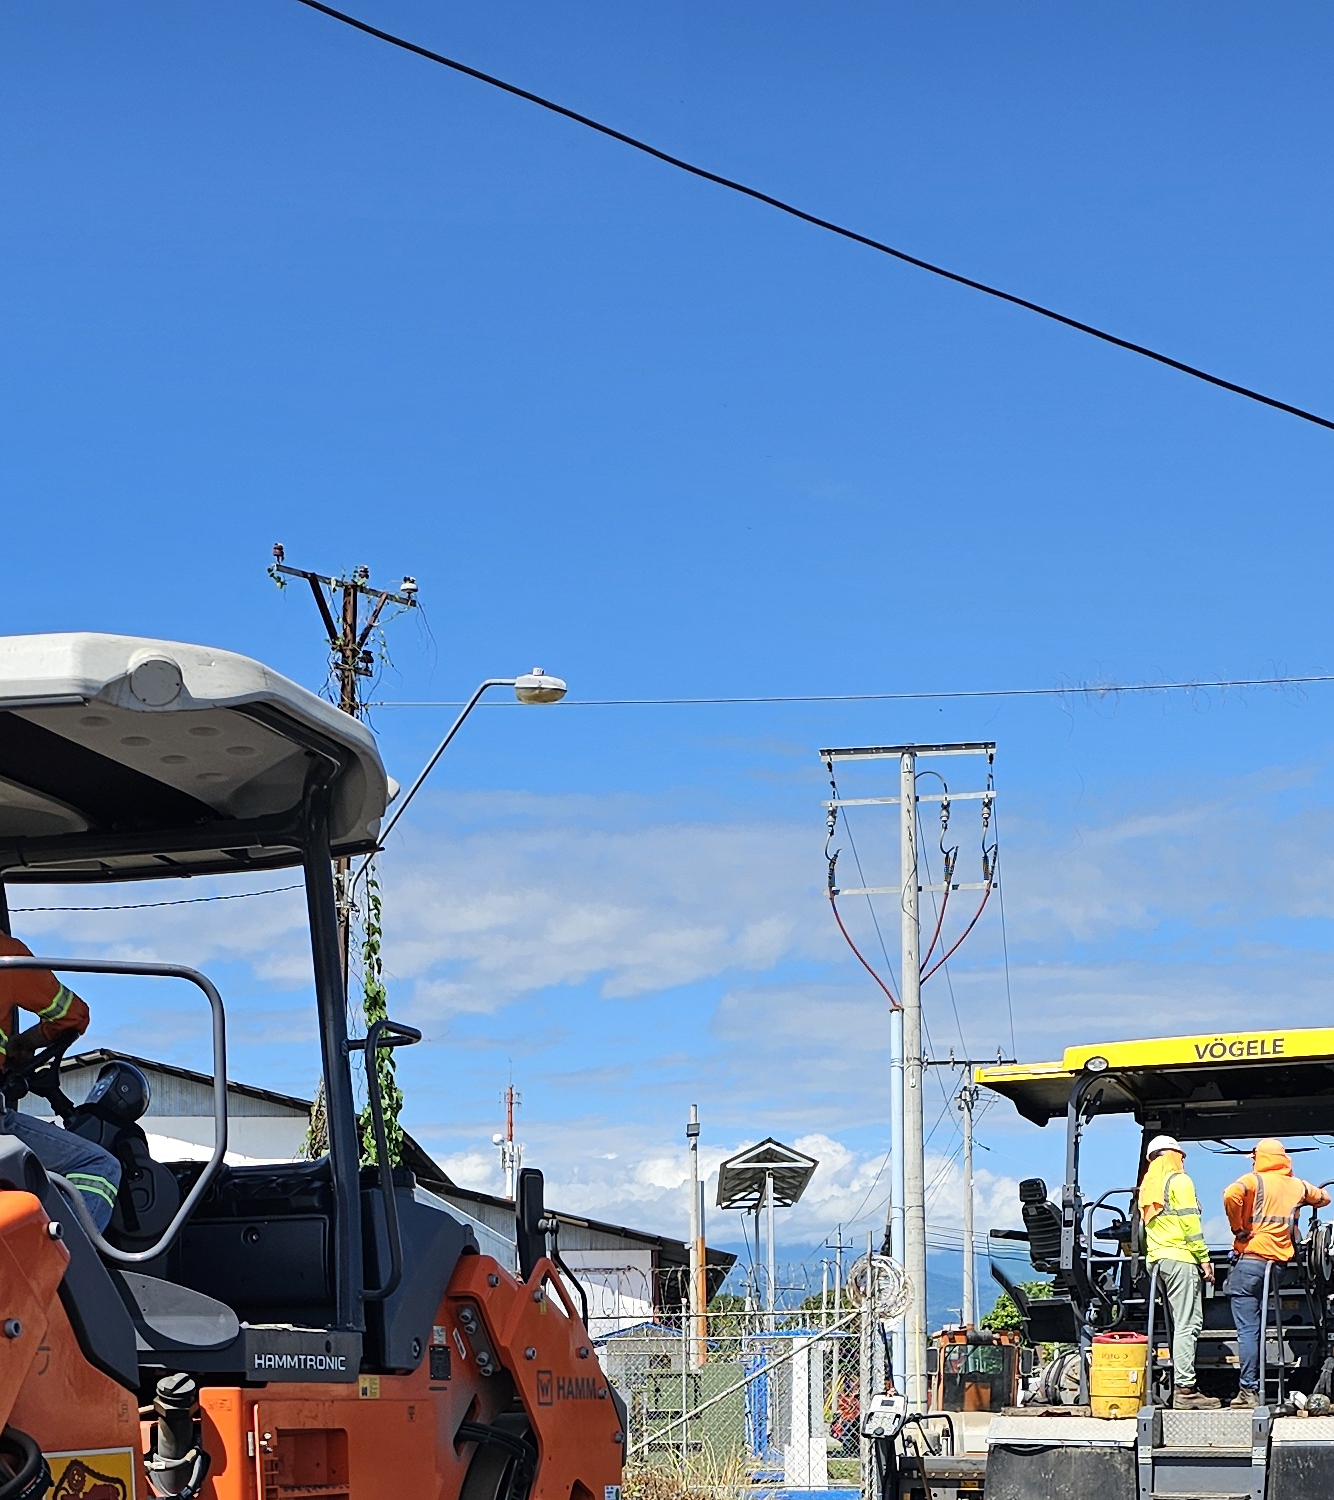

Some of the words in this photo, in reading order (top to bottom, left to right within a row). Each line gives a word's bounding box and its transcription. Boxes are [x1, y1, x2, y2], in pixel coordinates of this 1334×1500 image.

[1194, 1037, 1285, 1060] VÖGELE
[254, 1353, 346, 1371] HAMMTRONIC
[556, 1376, 597, 1400] HAMM
